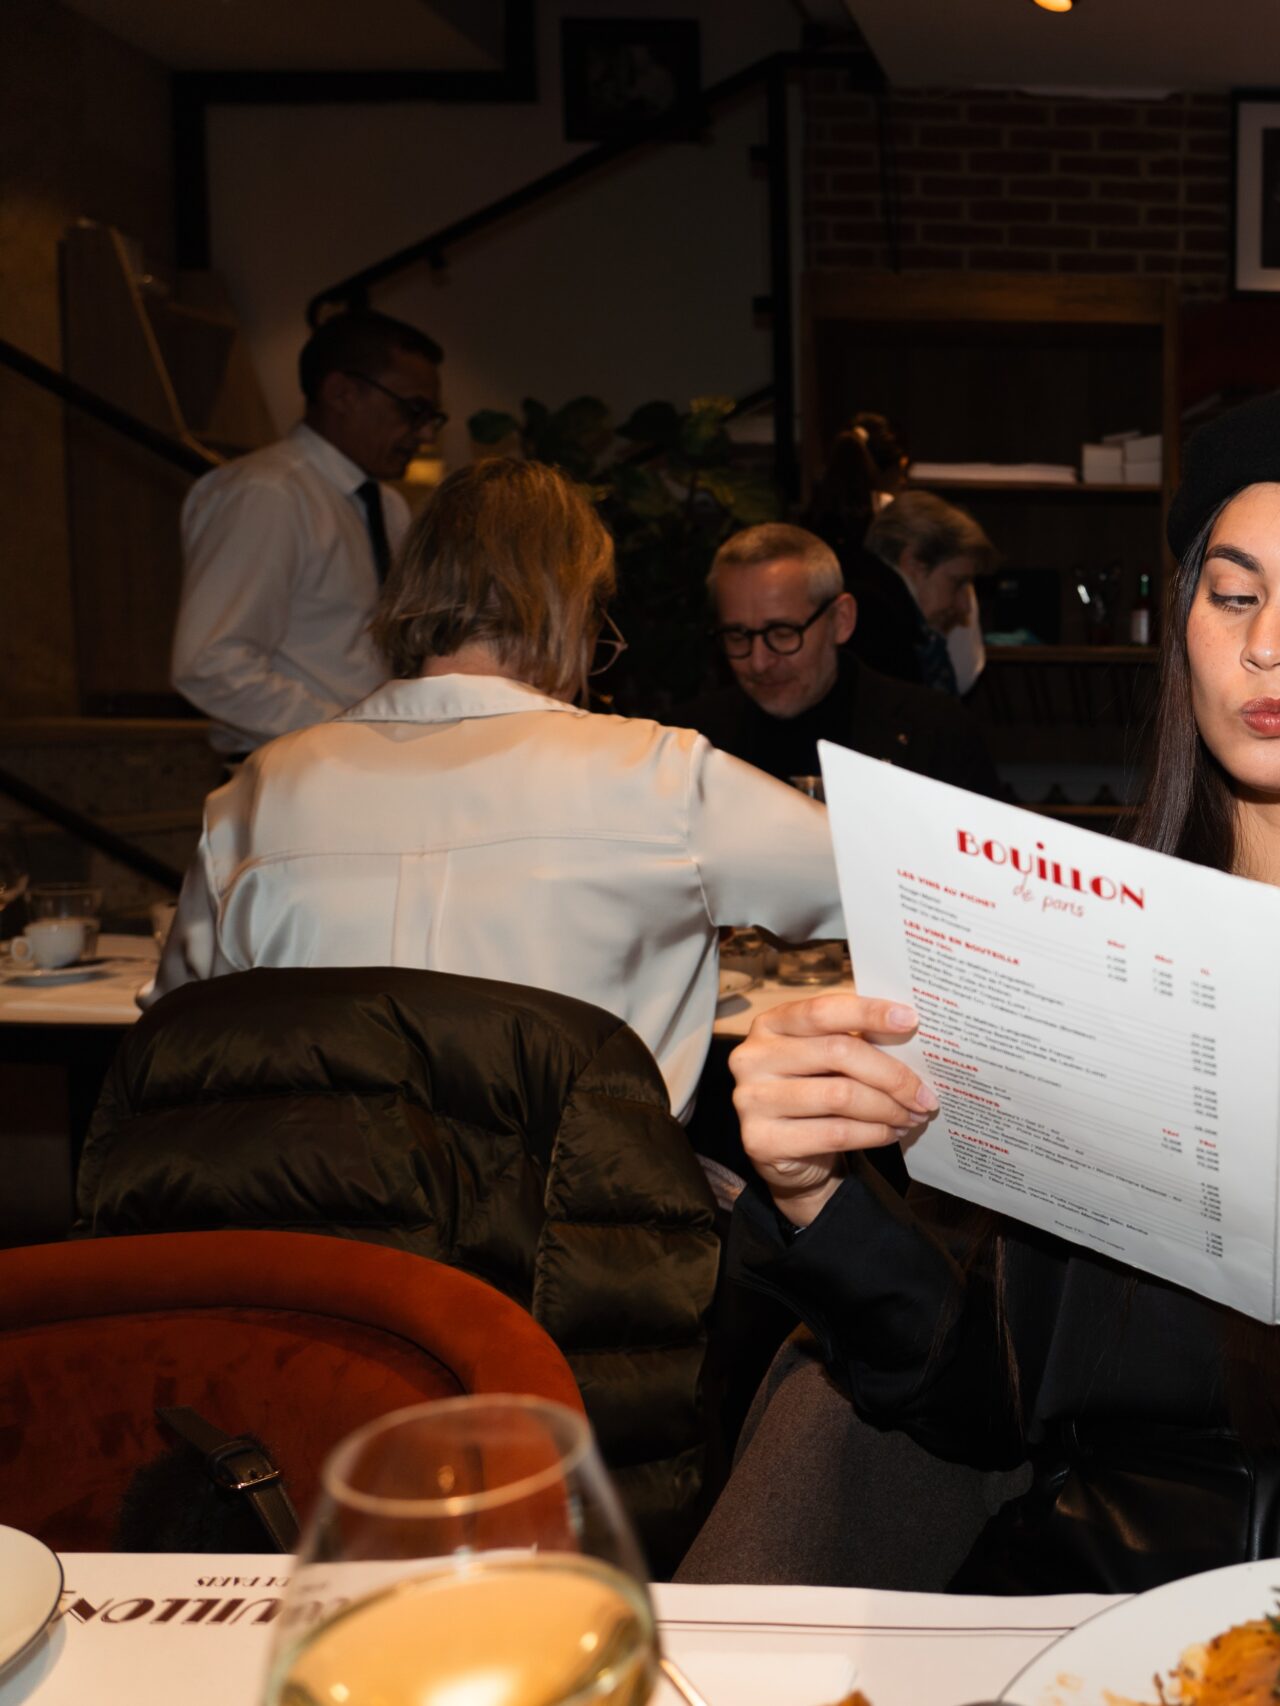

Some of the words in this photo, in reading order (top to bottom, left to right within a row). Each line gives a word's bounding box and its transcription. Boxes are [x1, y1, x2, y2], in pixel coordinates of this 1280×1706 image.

[956, 828, 1146, 910] BOUILLON
[895, 867, 914, 881] LES
[918, 876, 940, 890] VINS
[943, 885, 957, 896] AU
[959, 890, 996, 909] PICHET
[1041, 895, 1085, 918] paris
[903, 918, 920, 931] LES
[924, 926, 945, 940] VINS
[948, 934, 961, 946] EN
[964, 940, 1019, 966] BOUTEILLE
[922, 1049, 940, 1060] LES
[942, 1056, 978, 1072] BULLES
[933, 1080, 950, 1090] LES
[952, 1086, 1000, 1108] DIGESTIFS
[947, 1127, 958, 1136] LA
